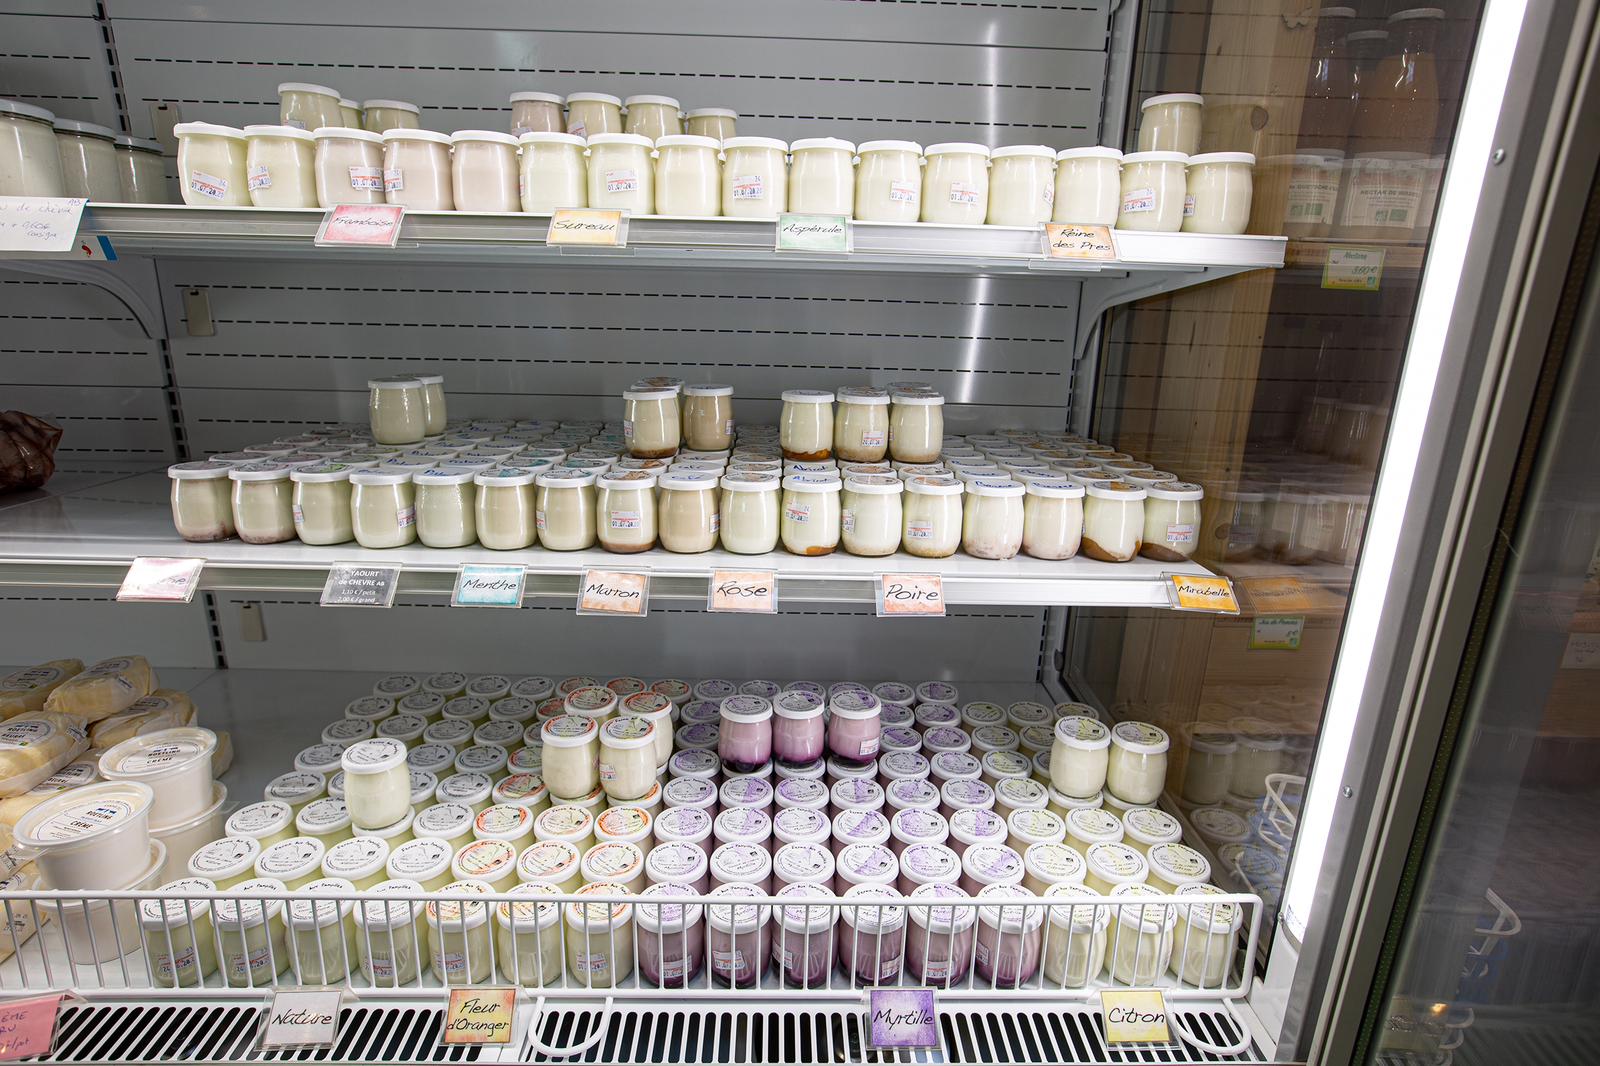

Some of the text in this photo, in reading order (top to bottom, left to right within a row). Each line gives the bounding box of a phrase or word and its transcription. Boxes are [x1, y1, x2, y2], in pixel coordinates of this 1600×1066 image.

[333, 215, 393, 227] Framboise
[553, 219, 616, 232] Sureau
[1060, 227, 1096, 239] Reine
[1052, 239, 1075, 249] des
[462, 578, 518, 591] Menthe
[585, 583, 641, 599] Marron
[716, 580, 768, 598] Rose
[885, 583, 939, 601] Poire
[1178, 586, 1231, 598] Mirabelle
[459, 998, 501, 1014] Fleur
[271, 1008, 333, 1025] Nature
[873, 1008, 935, 1031] Myrtille
[1108, 1007, 1165, 1023] Citron
[446, 1018, 510, 1037] d'Oranger
